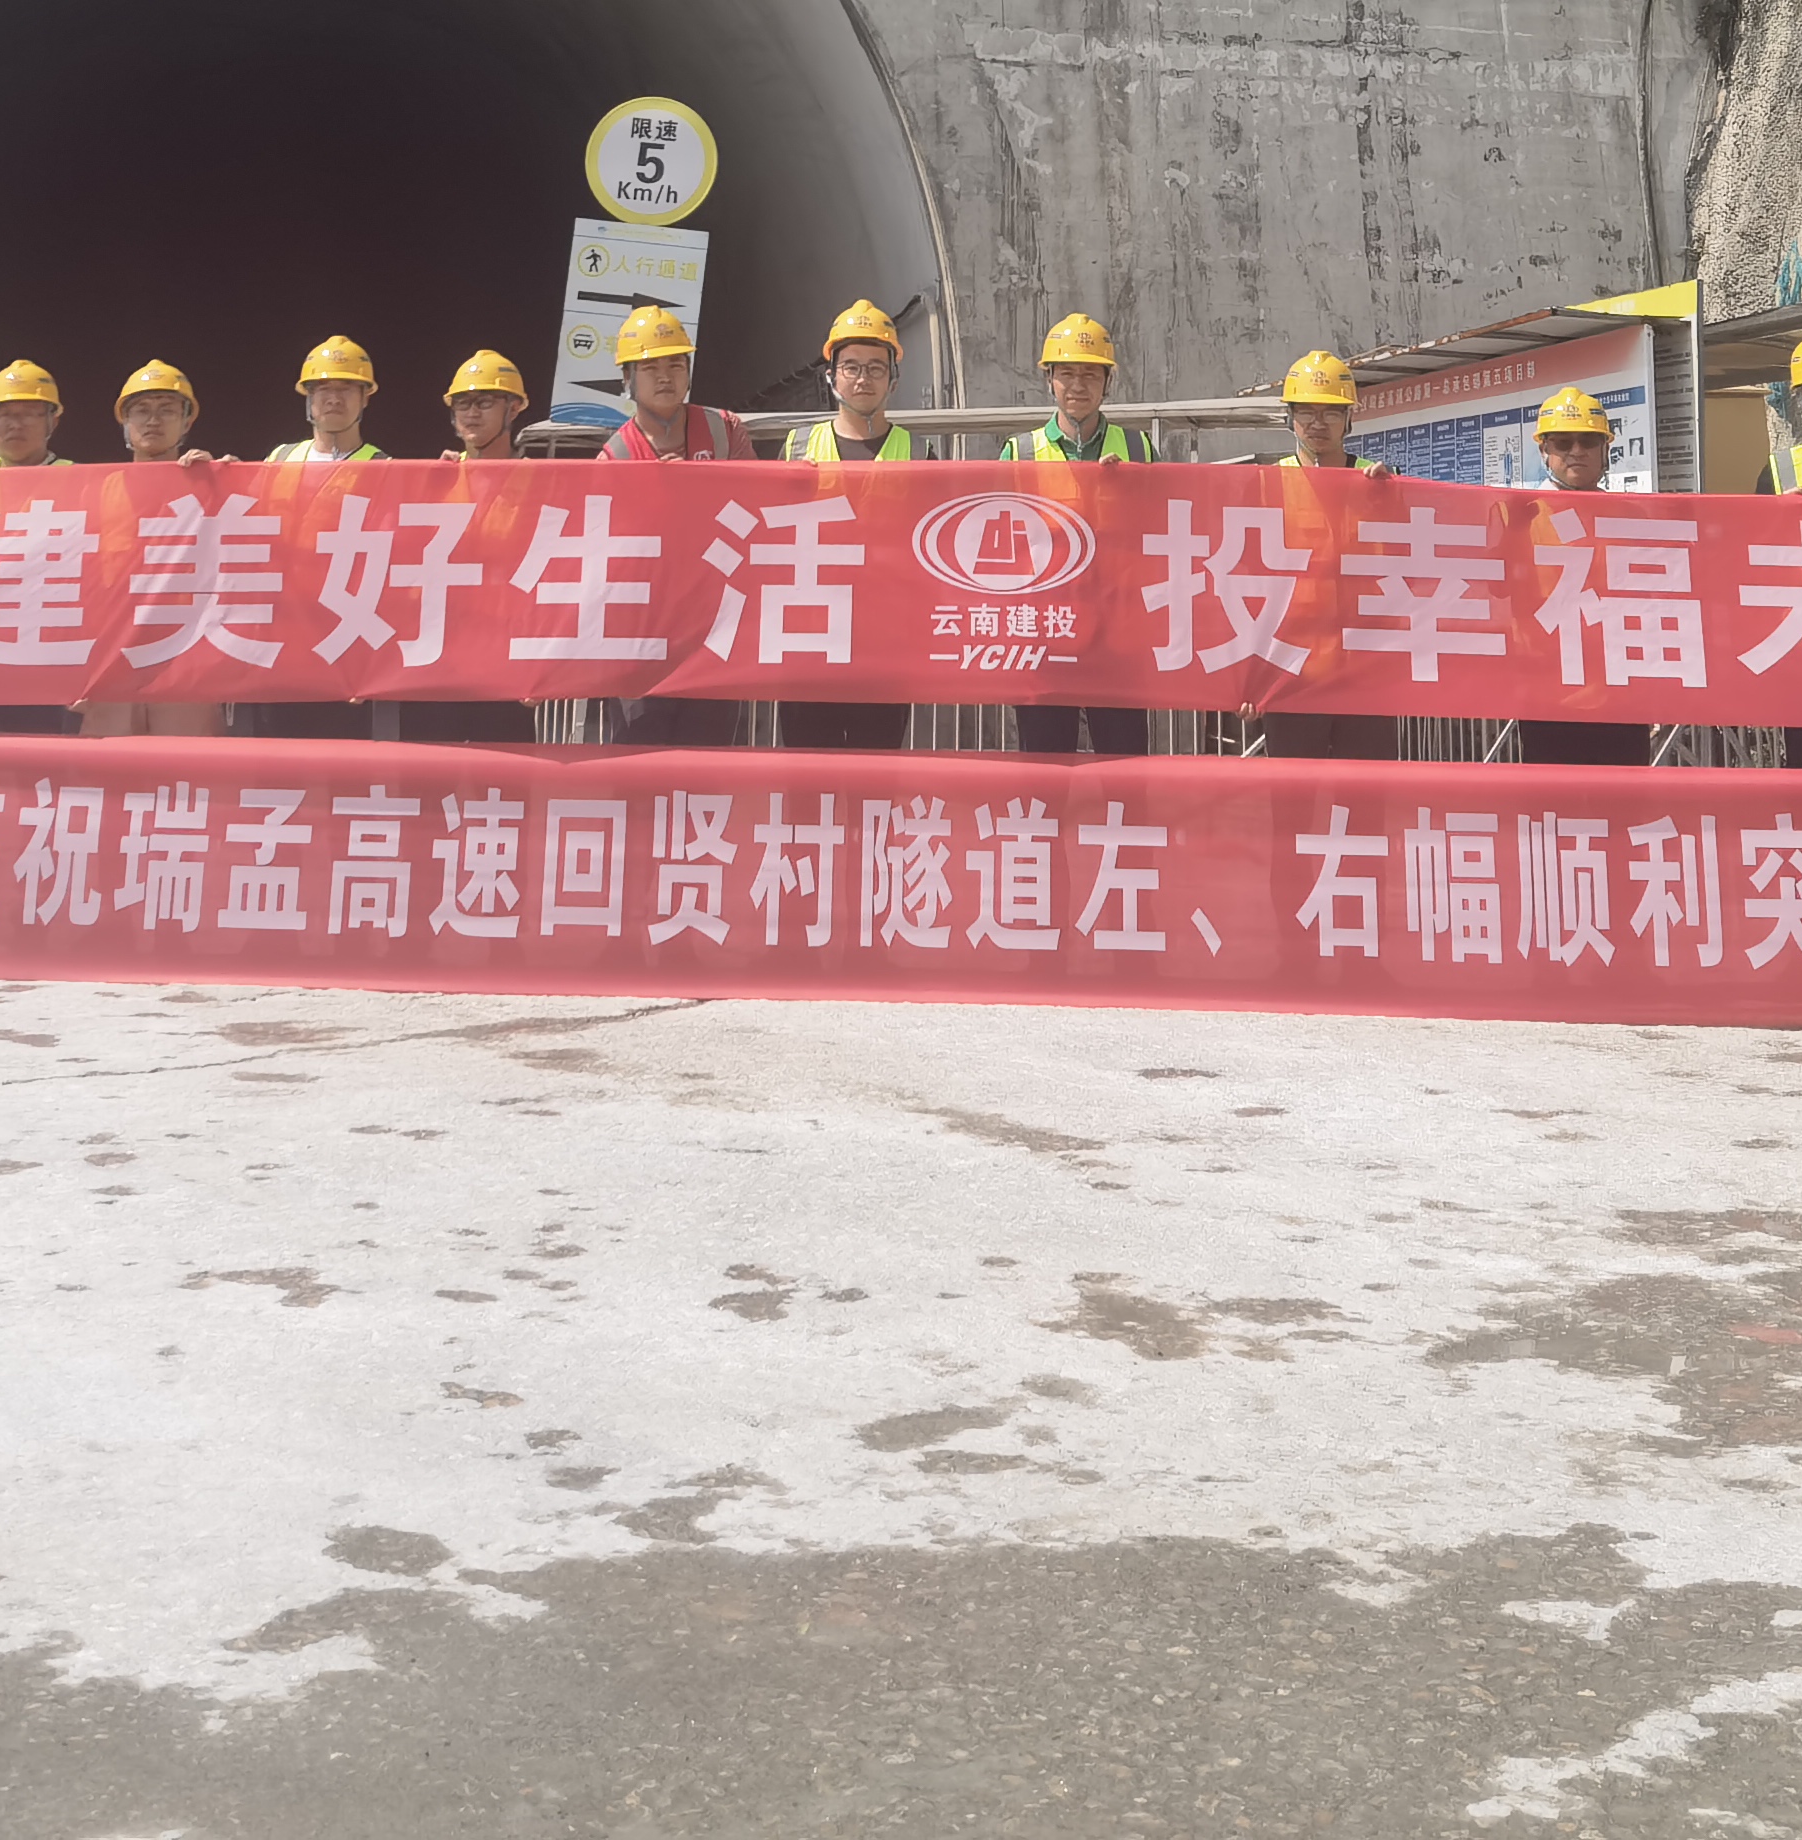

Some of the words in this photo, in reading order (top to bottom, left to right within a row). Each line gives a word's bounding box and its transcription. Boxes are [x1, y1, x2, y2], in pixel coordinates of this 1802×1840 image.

[630, 117, 679, 142] 限速
[635, 141, 666, 185] 5
[617, 180, 679, 206] Km/h
[613, 254, 699, 282] 人行通道
[929, 603, 1078, 640] 云南建投
[958, 645, 1048, 672] YCIH
